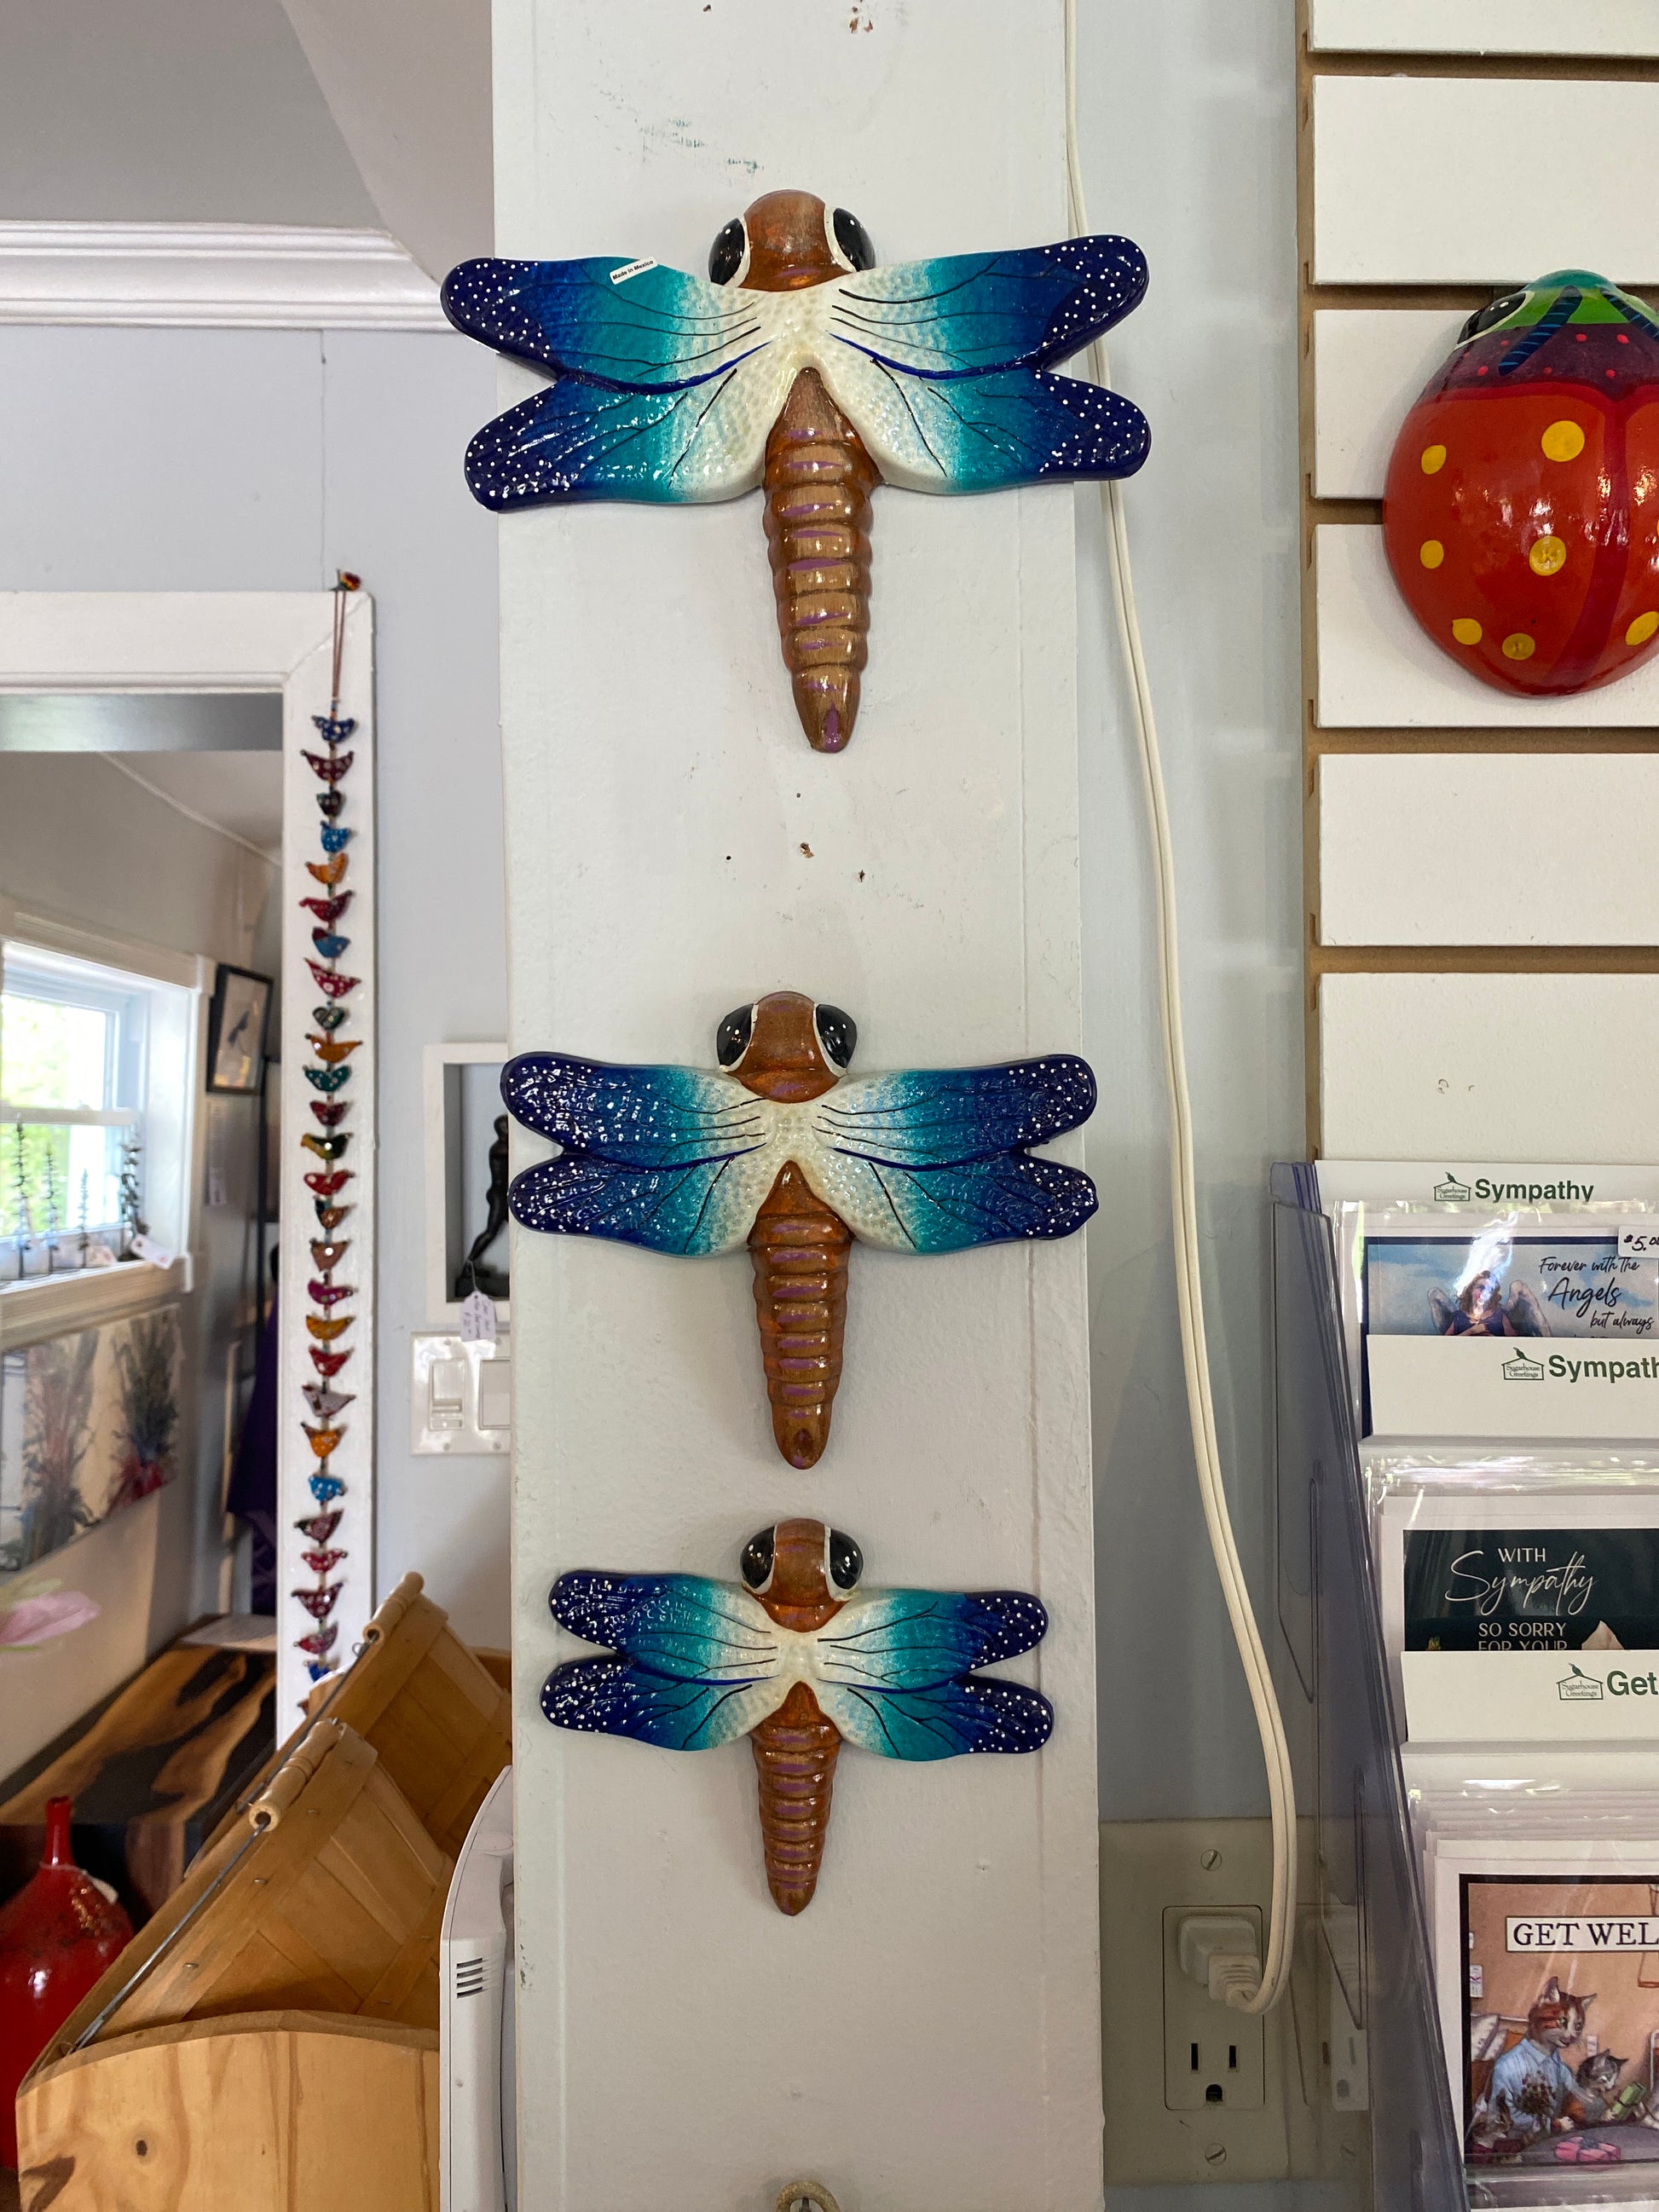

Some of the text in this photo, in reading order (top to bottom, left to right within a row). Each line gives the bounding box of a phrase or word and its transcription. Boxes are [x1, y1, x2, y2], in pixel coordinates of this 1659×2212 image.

[612, 270, 627, 280] Made
[633, 260, 654, 270] Mexico
[1475, 1178, 1594, 1204] Sympathy
[1539, 1256, 1587, 1273] Forever
[1592, 1256, 1618, 1273] with
[1547, 1277, 1622, 1318] Angels
[1589, 1310, 1655, 1334] but always
[1506, 1362, 1541, 1372] Sugarhouse
[1509, 1370, 1539, 1378] Greetings
[1497, 1547, 1546, 1563] WITH
[1444, 1550, 1597, 1617] Sympathy
[1478, 1622, 1567, 1637] SO SORRY
[1478, 1640, 1568, 1651] FOR YOUR
[1561, 1680, 1599, 1691] Sugarhouse
[1607, 1671, 1659, 1696] Get
[1565, 1689, 1598, 1698] Greetings
[1513, 1922, 1659, 1946] GET WEL
